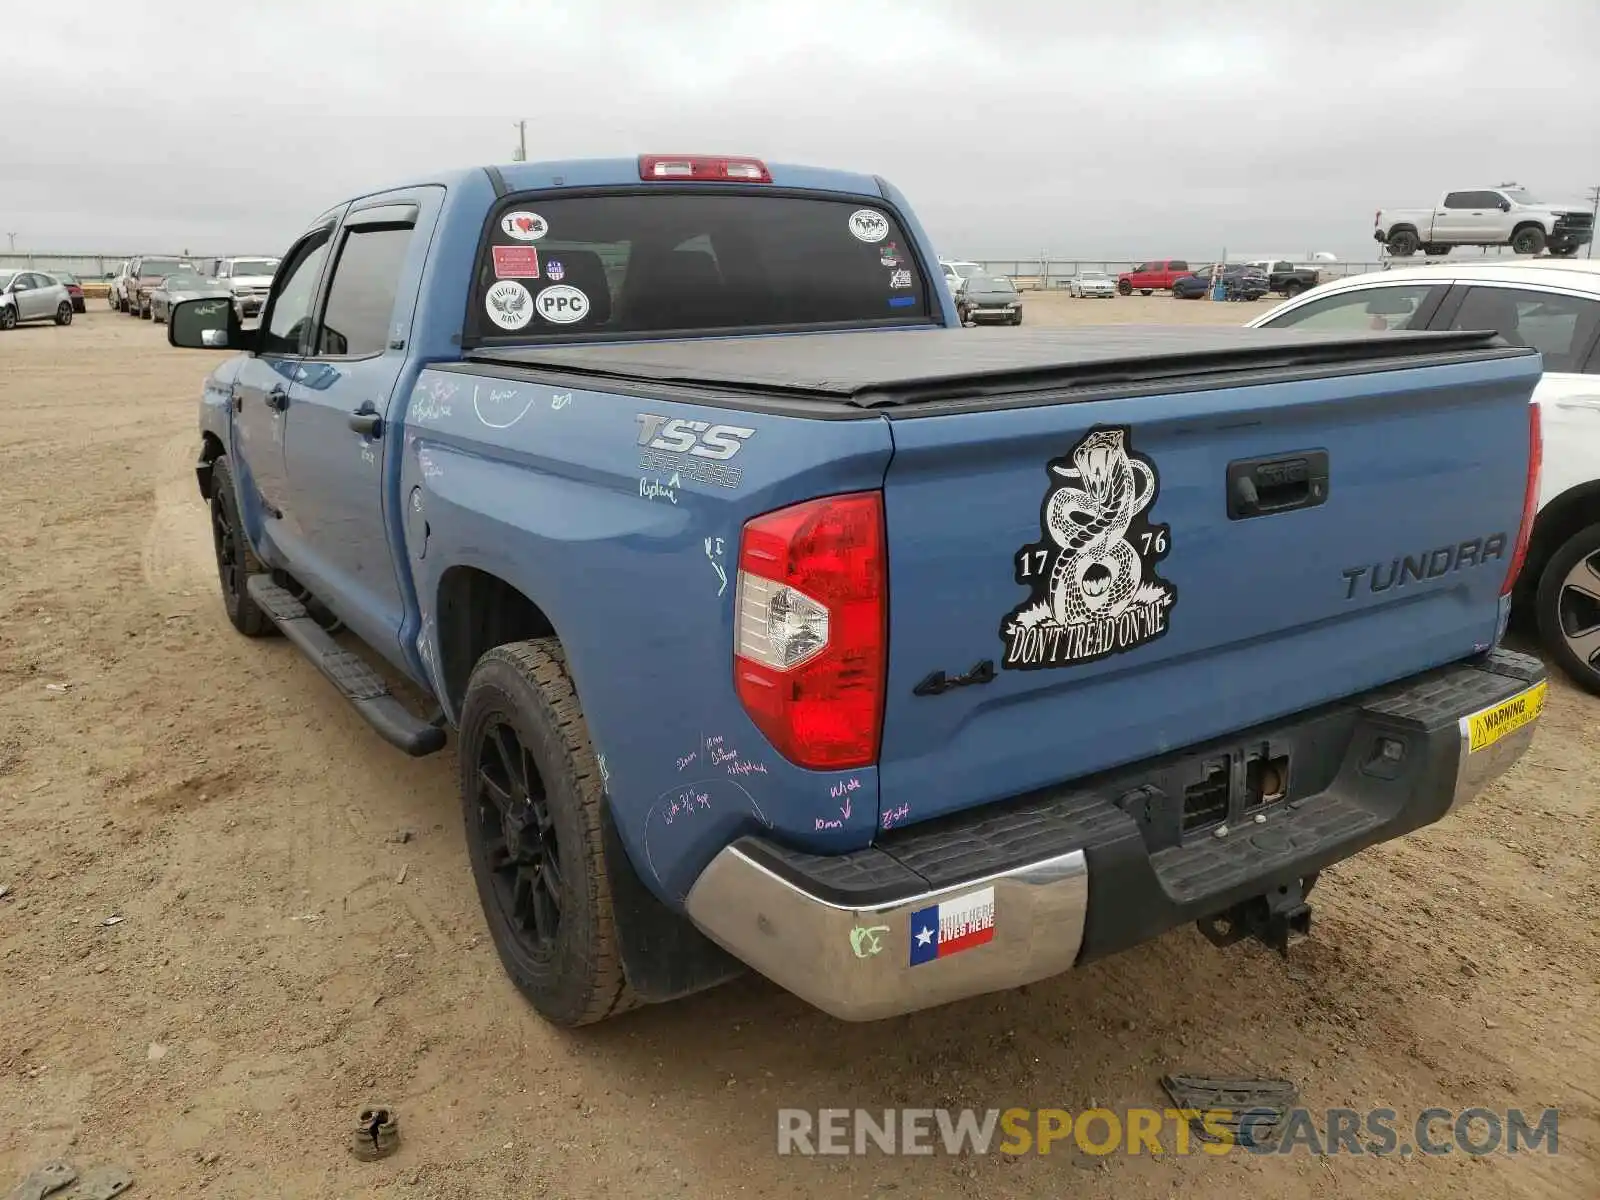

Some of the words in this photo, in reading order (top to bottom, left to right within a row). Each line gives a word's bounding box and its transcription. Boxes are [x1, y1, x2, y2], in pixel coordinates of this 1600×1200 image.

[495, 286, 518, 297] HIGH
[543, 296, 582, 312] PPC
[635, 413, 757, 460] TSS
[1341, 531, 1507, 600] TUNDRA
[1008, 624, 1065, 664] DON'T
[1062, 614, 1120, 660] TREAD
[1119, 607, 1145, 647] ON
[1143, 600, 1166, 639] ME
[1484, 699, 1526, 732] WARNING
[938, 921, 966, 944] LIVES
[969, 915, 994, 934] HERE
[940, 911, 968, 931] BUILT
[969, 901, 994, 919] HERE
